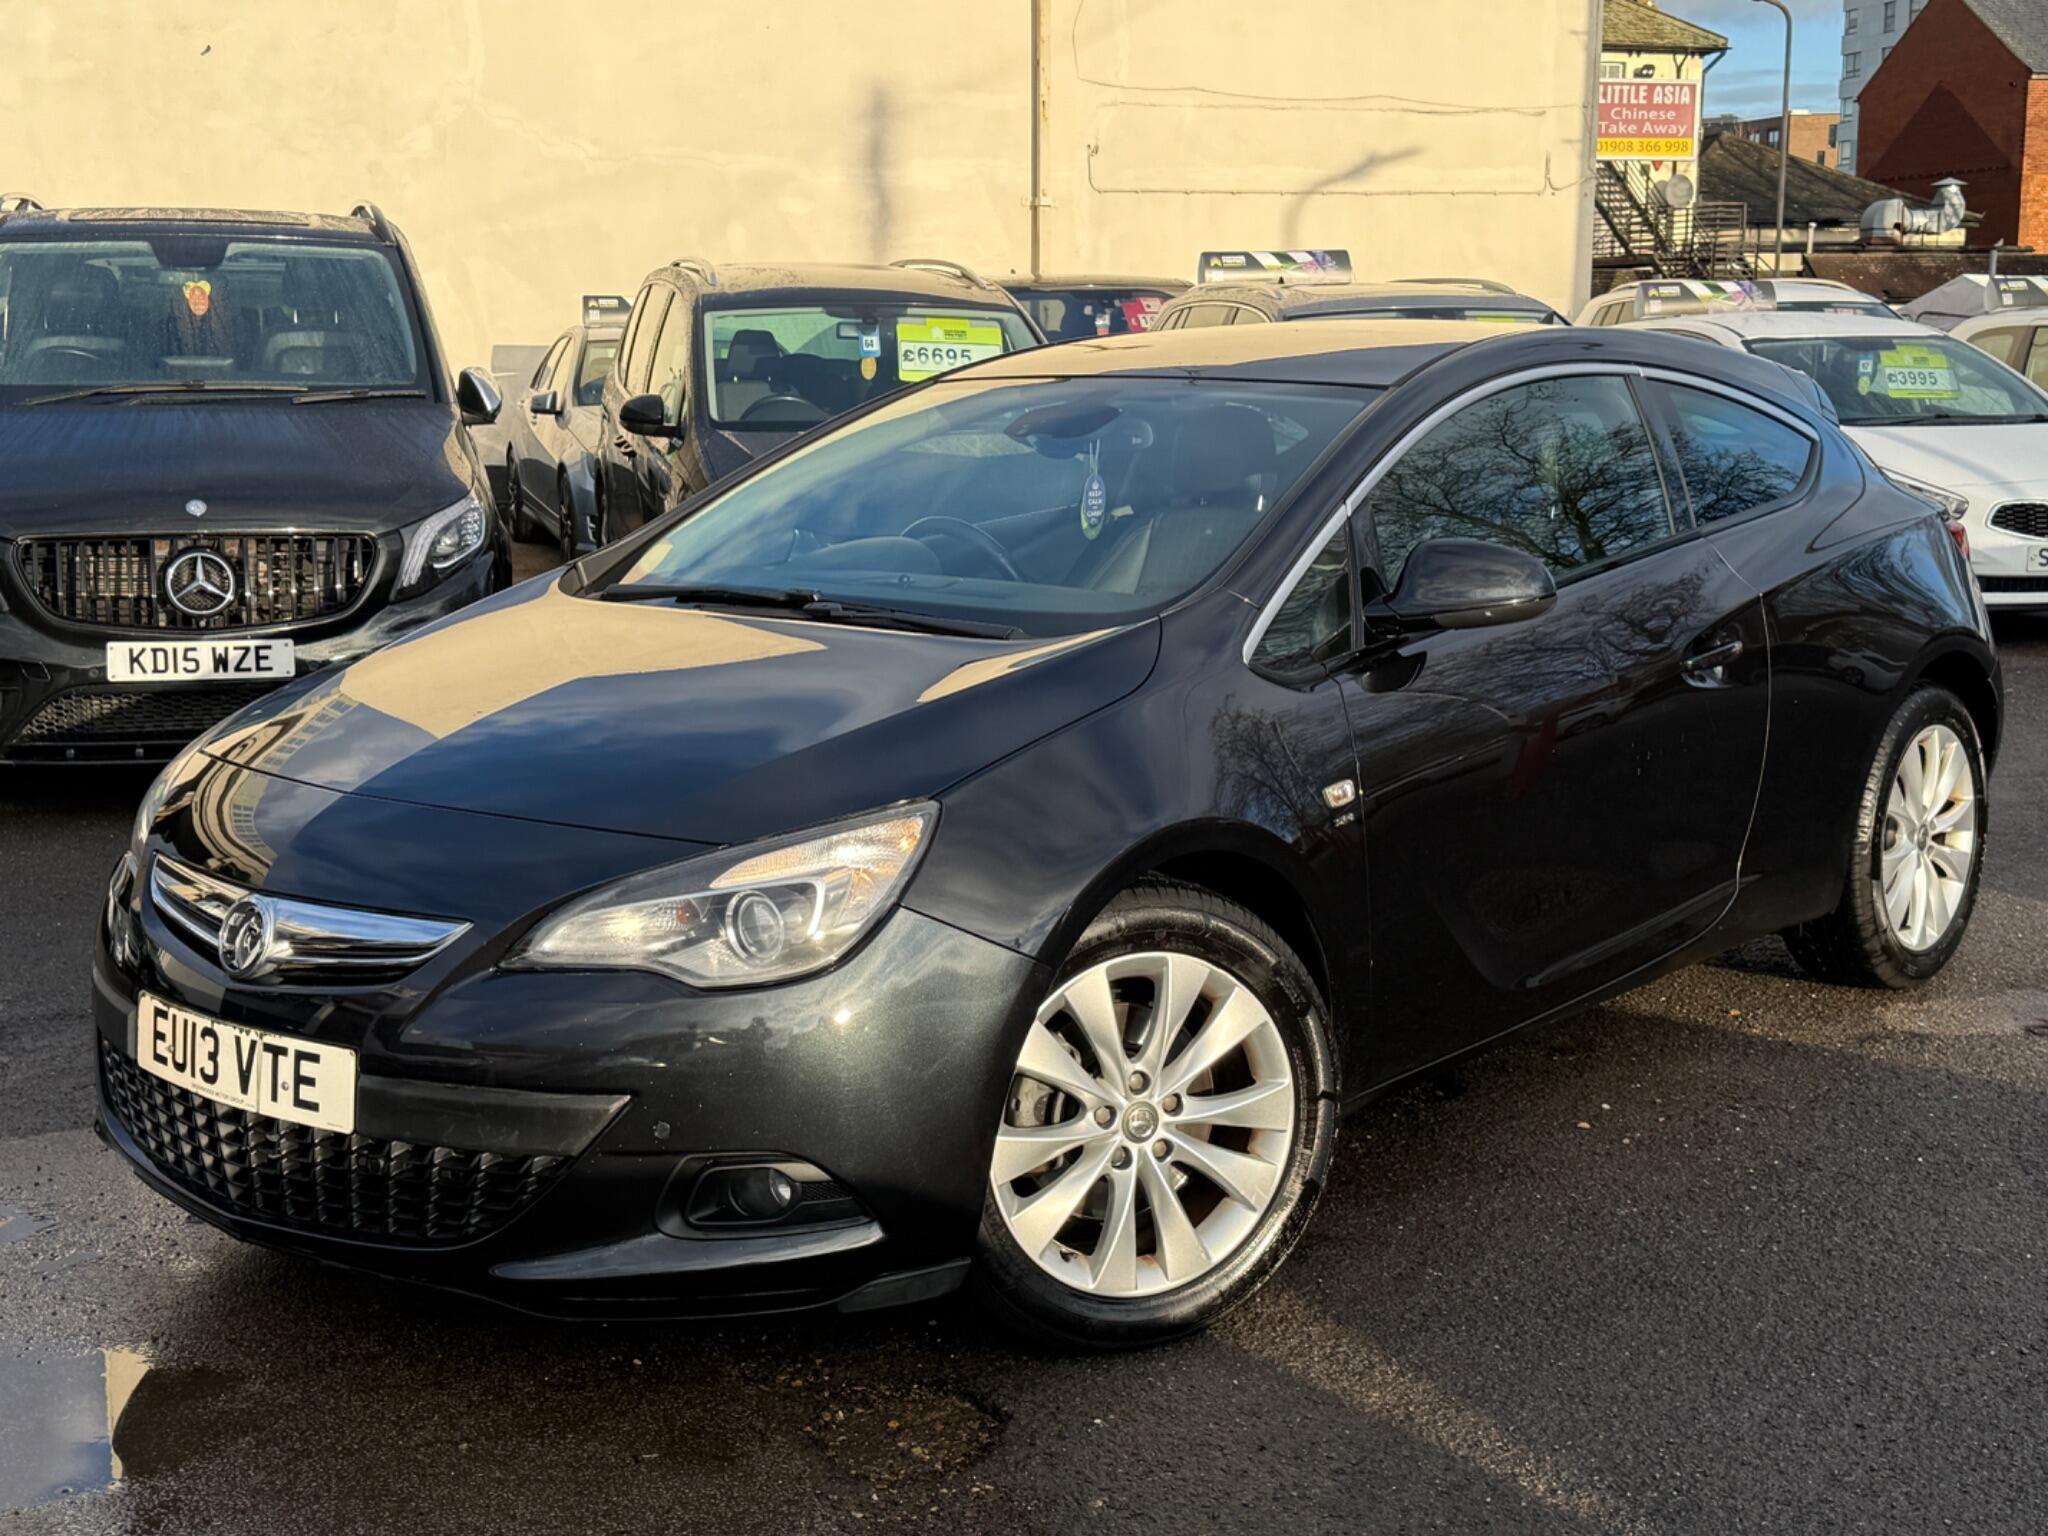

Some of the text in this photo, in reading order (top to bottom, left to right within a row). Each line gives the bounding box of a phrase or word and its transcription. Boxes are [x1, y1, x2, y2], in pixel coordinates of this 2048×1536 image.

[1599, 84, 1690, 104] LITTLE ASIA
[1610, 107, 1676, 120] Chinese
[1599, 121, 1687, 137] Take Away
[1638, 141, 1661, 152] 366
[1664, 141, 1689, 152] 998
[903, 347, 972, 366] £6695
[129, 645, 273, 674] KD15 WZE
[152, 1005, 321, 1113] EU13 VTE
